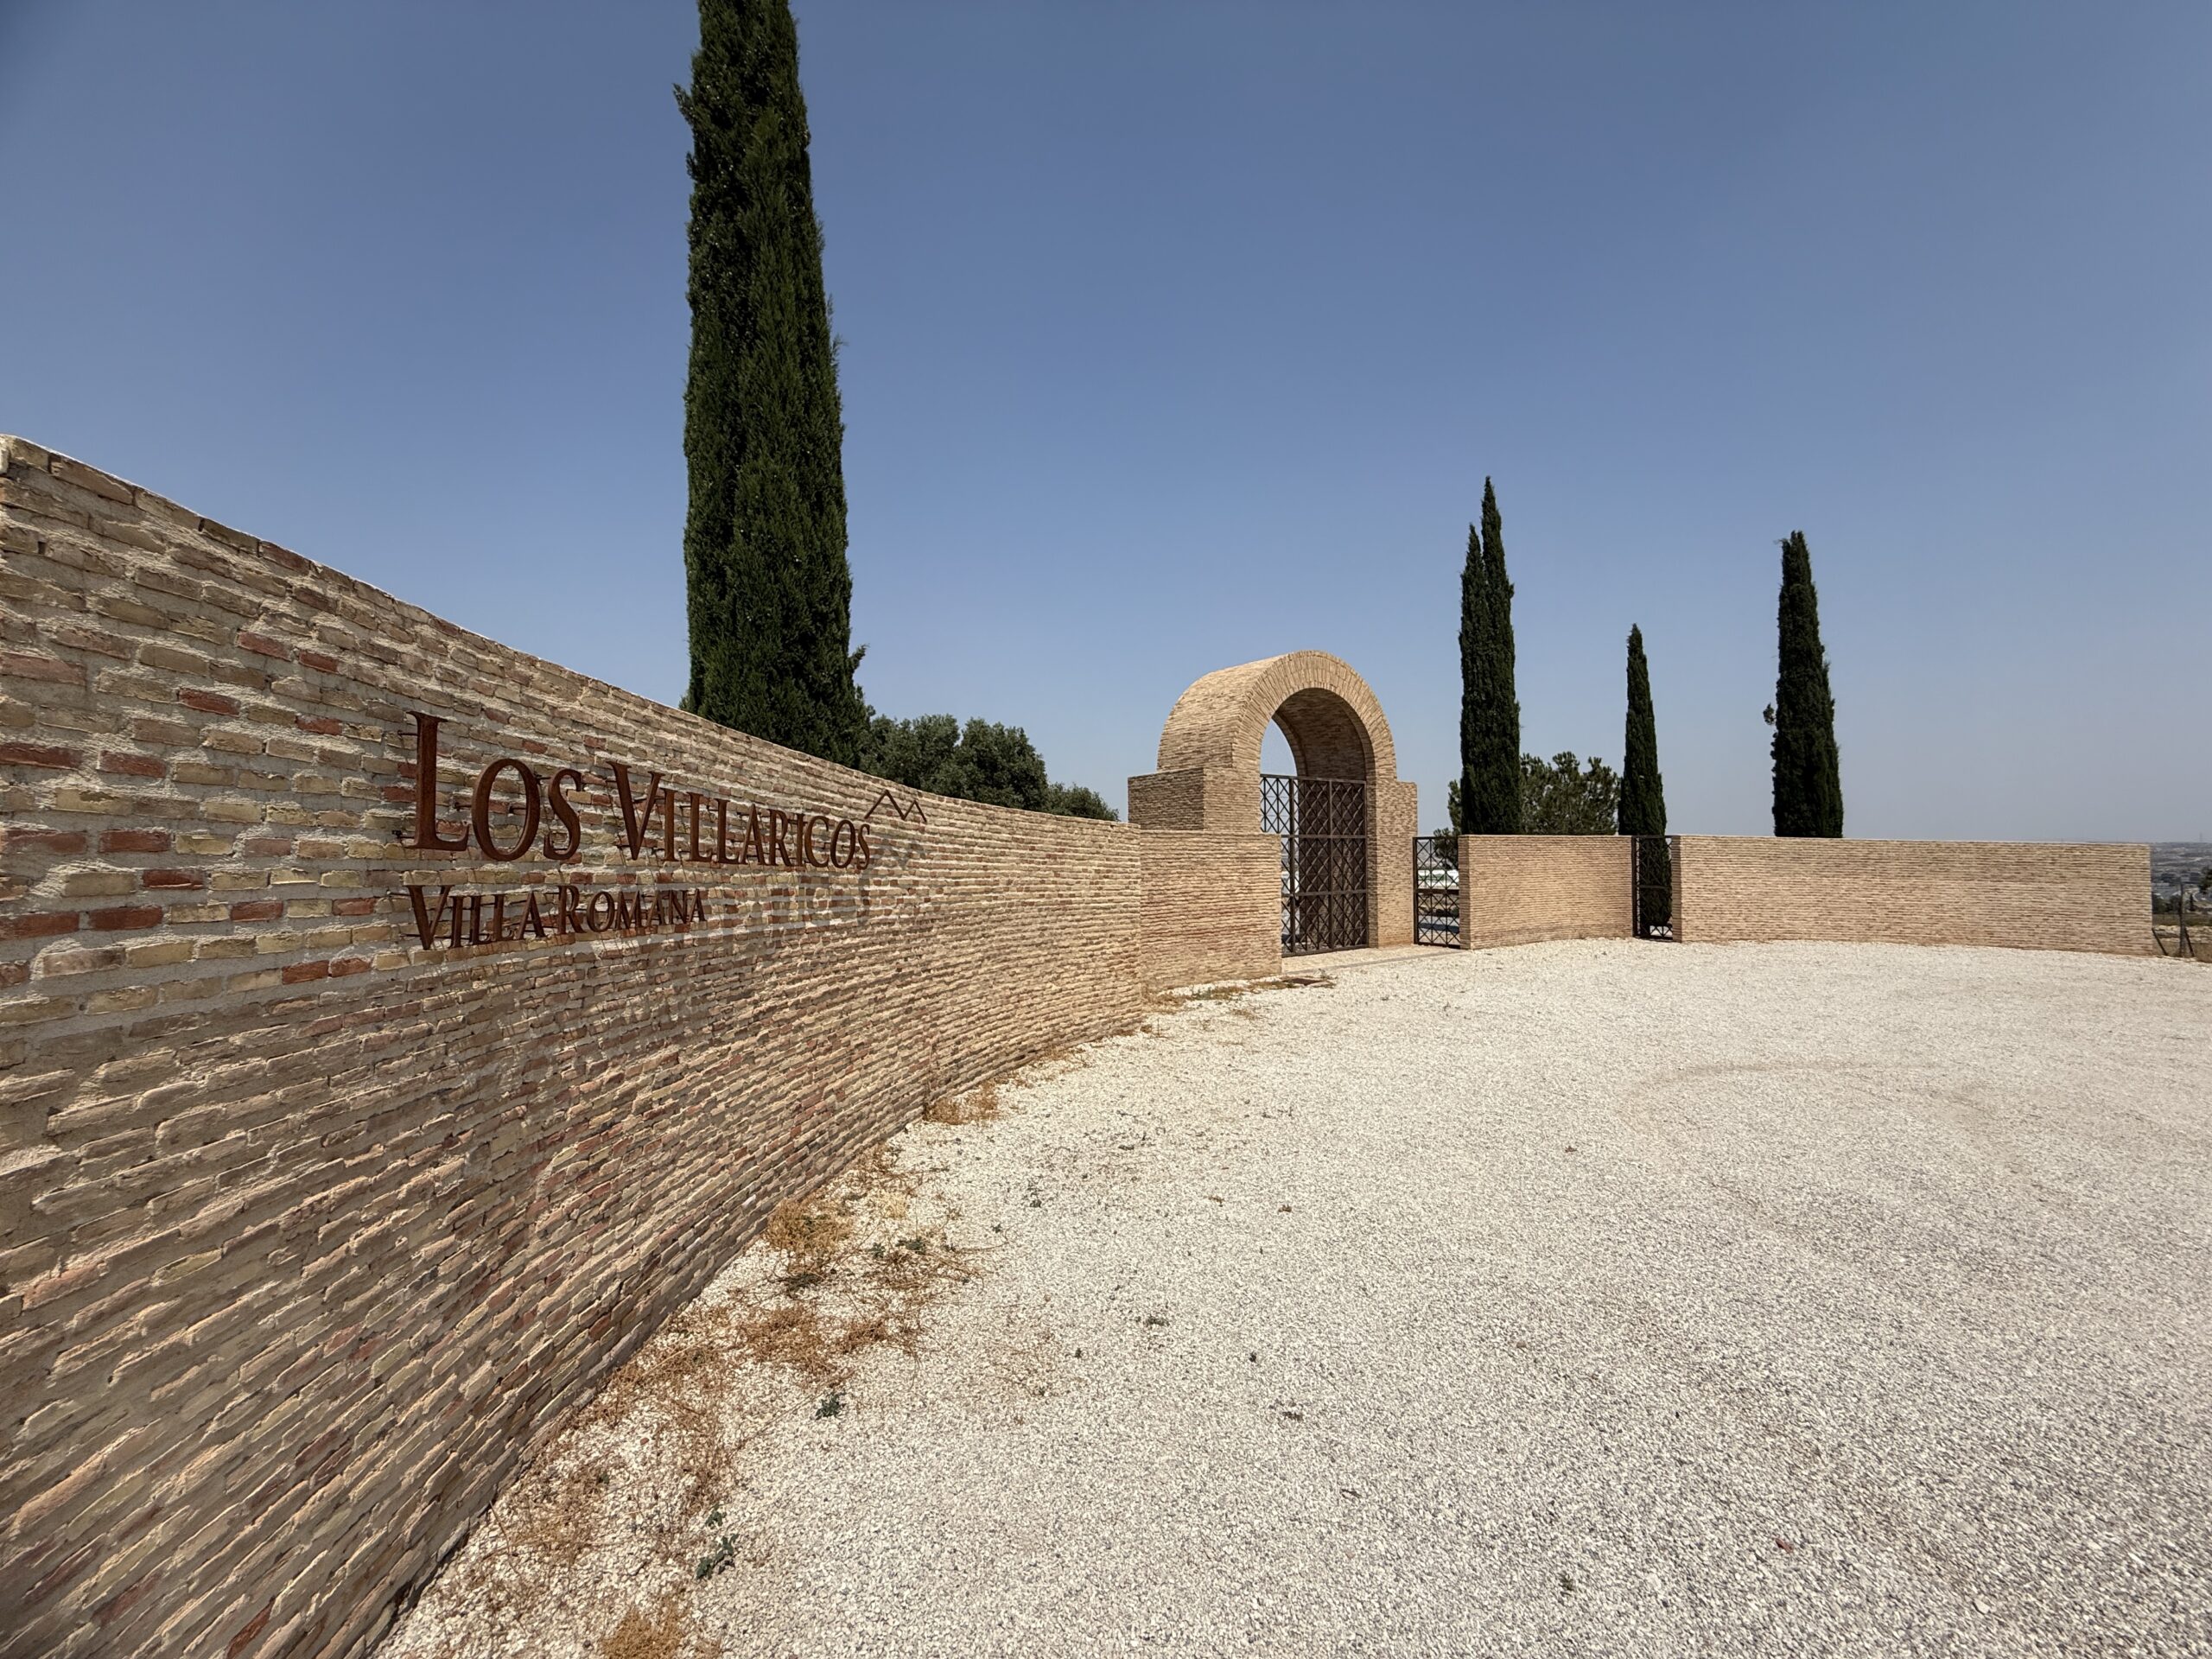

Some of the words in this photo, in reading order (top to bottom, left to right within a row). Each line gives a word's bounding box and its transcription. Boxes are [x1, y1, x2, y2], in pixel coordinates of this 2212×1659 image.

[408, 711, 585, 861] LOS
[608, 761, 870, 870] VILLARICOS
[407, 885, 545, 950] VILLA
[558, 885, 707, 934] ROMANA
